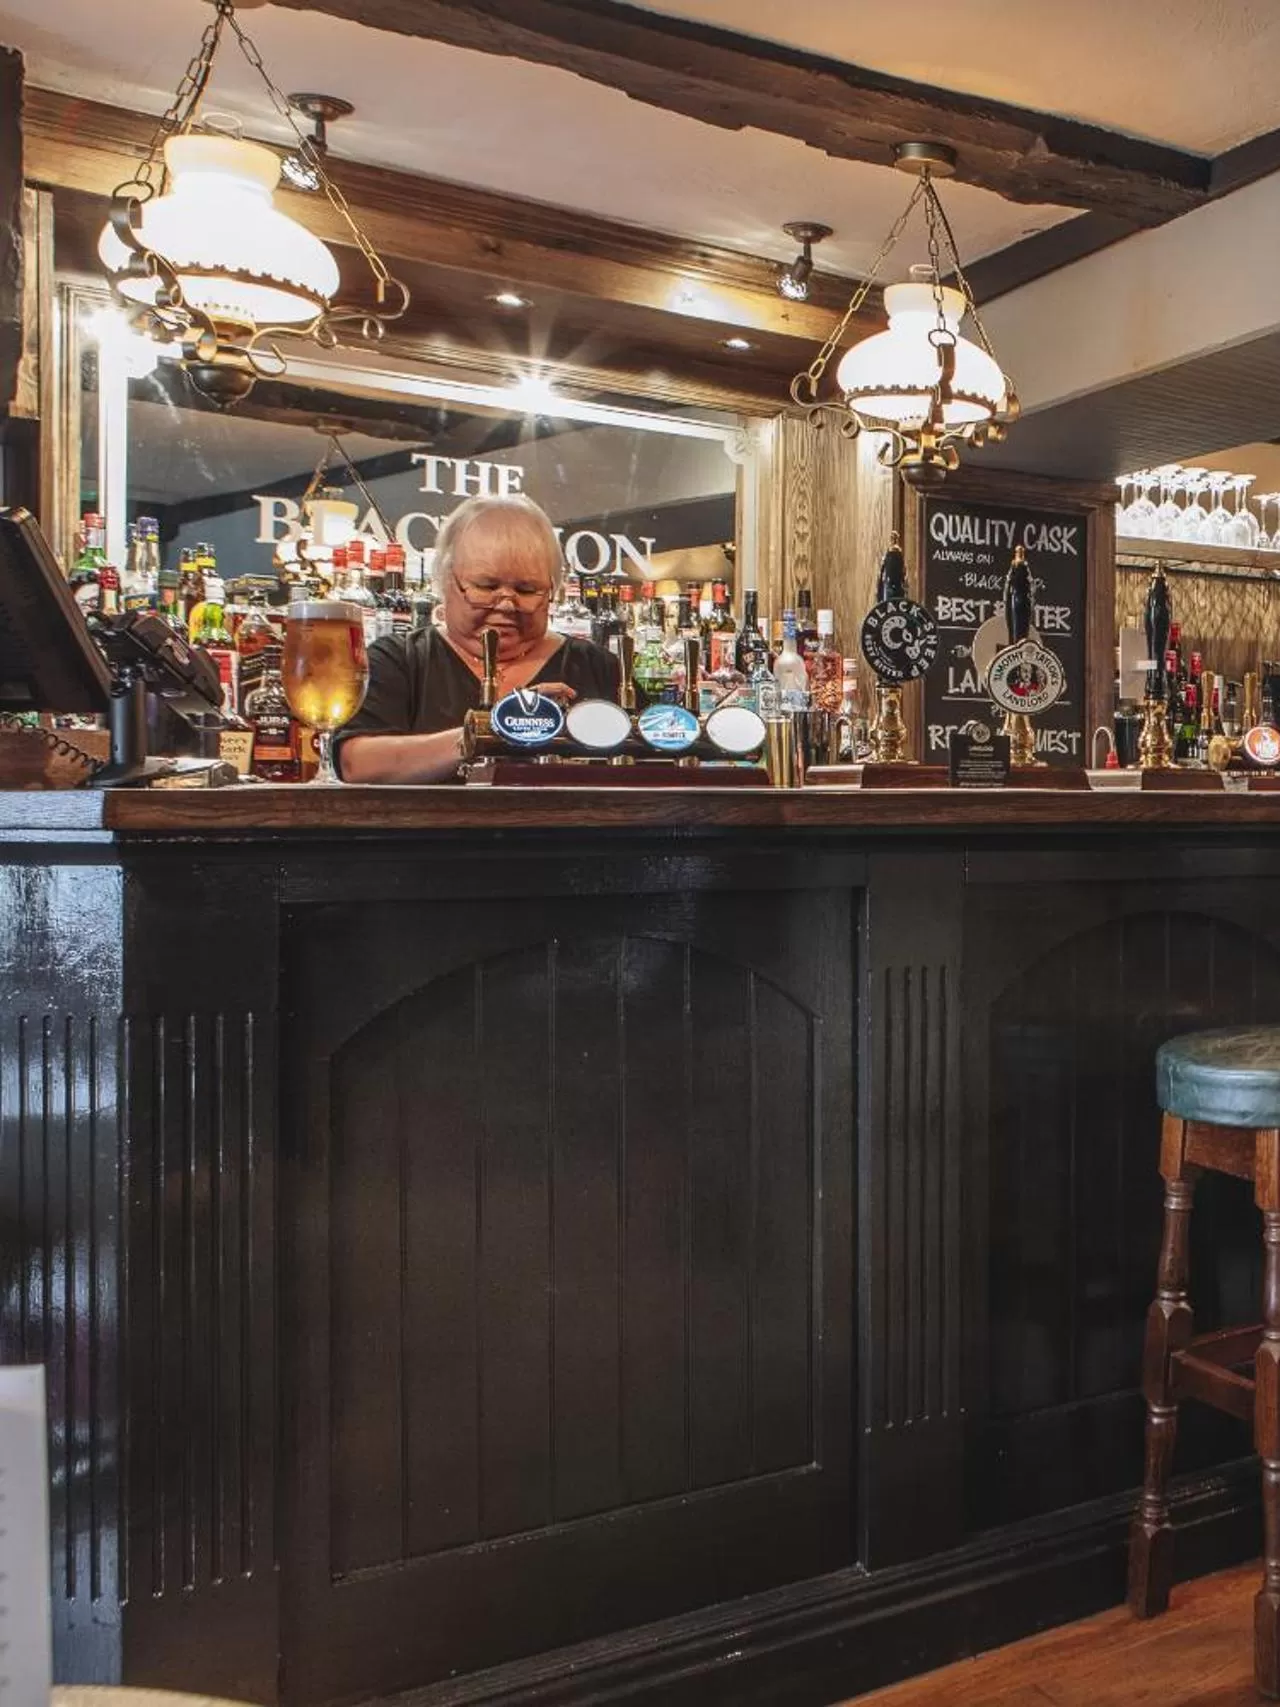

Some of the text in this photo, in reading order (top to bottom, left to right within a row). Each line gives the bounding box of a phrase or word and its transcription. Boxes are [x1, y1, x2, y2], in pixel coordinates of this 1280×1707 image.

[411, 453, 526, 498] THE
[929, 512, 1078, 556] QUALITY CASK
[932, 549, 974, 565] ALWAYS
[934, 595, 990, 623] BEST
[866, 601, 921, 628] BLACK
[911, 621, 938, 677] SHEEP
[994, 651, 1023, 681] TIMOTHY
[1002, 689, 1049, 708] LANDLORD
[504, 716, 556, 728] GUINNESS
